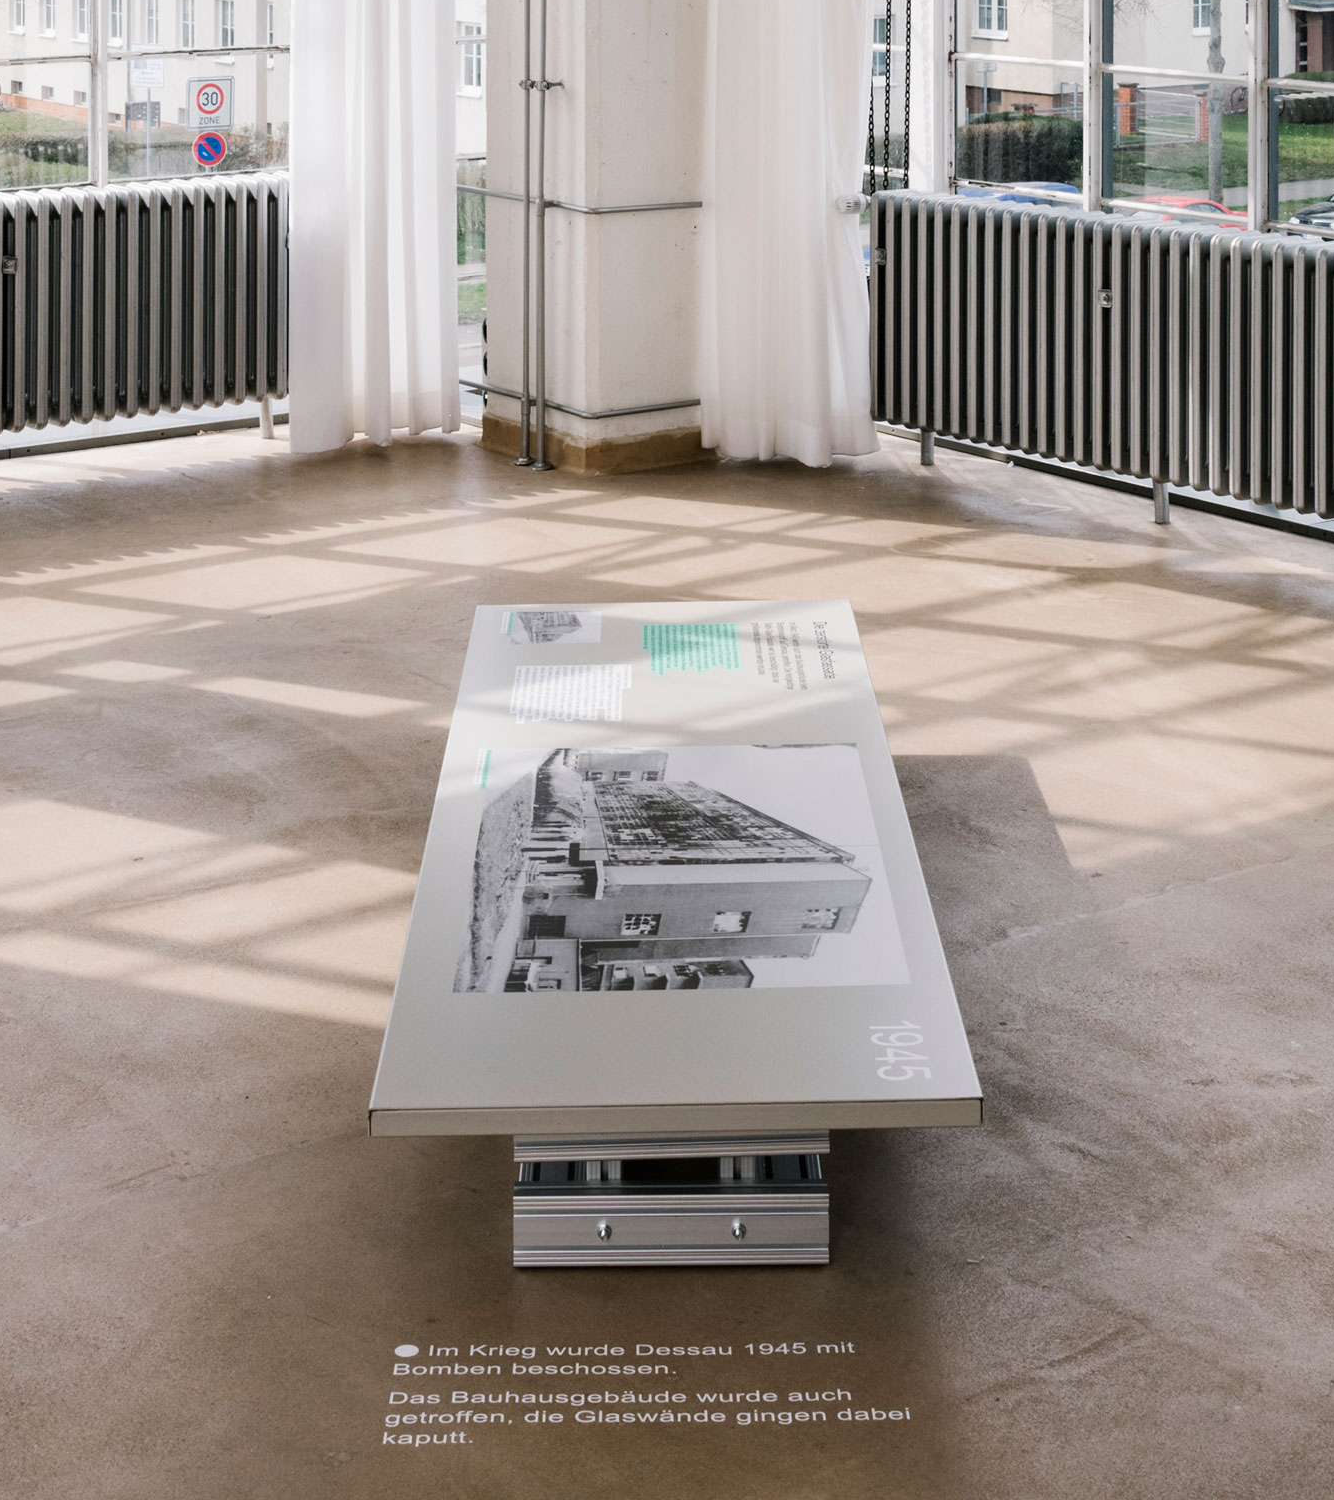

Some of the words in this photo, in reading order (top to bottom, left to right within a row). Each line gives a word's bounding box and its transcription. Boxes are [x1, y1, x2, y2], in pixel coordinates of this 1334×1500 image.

[202, 92, 219, 106] 30
[199, 116, 220, 126] ZONE
[869, 1020, 932, 1080] 1945
[428, 1344, 459, 1357] Im
[469, 1344, 536, 1359] Krieg
[546, 1344, 625, 1357] wurde
[635, 1343, 733, 1356] Dessau
[744, 1342, 807, 1355] 1945
[817, 1341, 856, 1354] mit
[392, 1363, 501, 1376] Bomben
[512, 1362, 677, 1375] beschossen.
[388, 1391, 441, 1405] Das
[451, 1389, 687, 1407] Bauhausgebäude
[697, 1389, 778, 1403] wurde
[787, 1388, 852, 1401] auch
[385, 1410, 513, 1428] getroffen,
[524, 1410, 564, 1423] die
[574, 1409, 726, 1424] Glaswände
[736, 1409, 827, 1425] gingen
[836, 1407, 911, 1421] dabei
[382, 1431, 473, 1448] kaputt.
